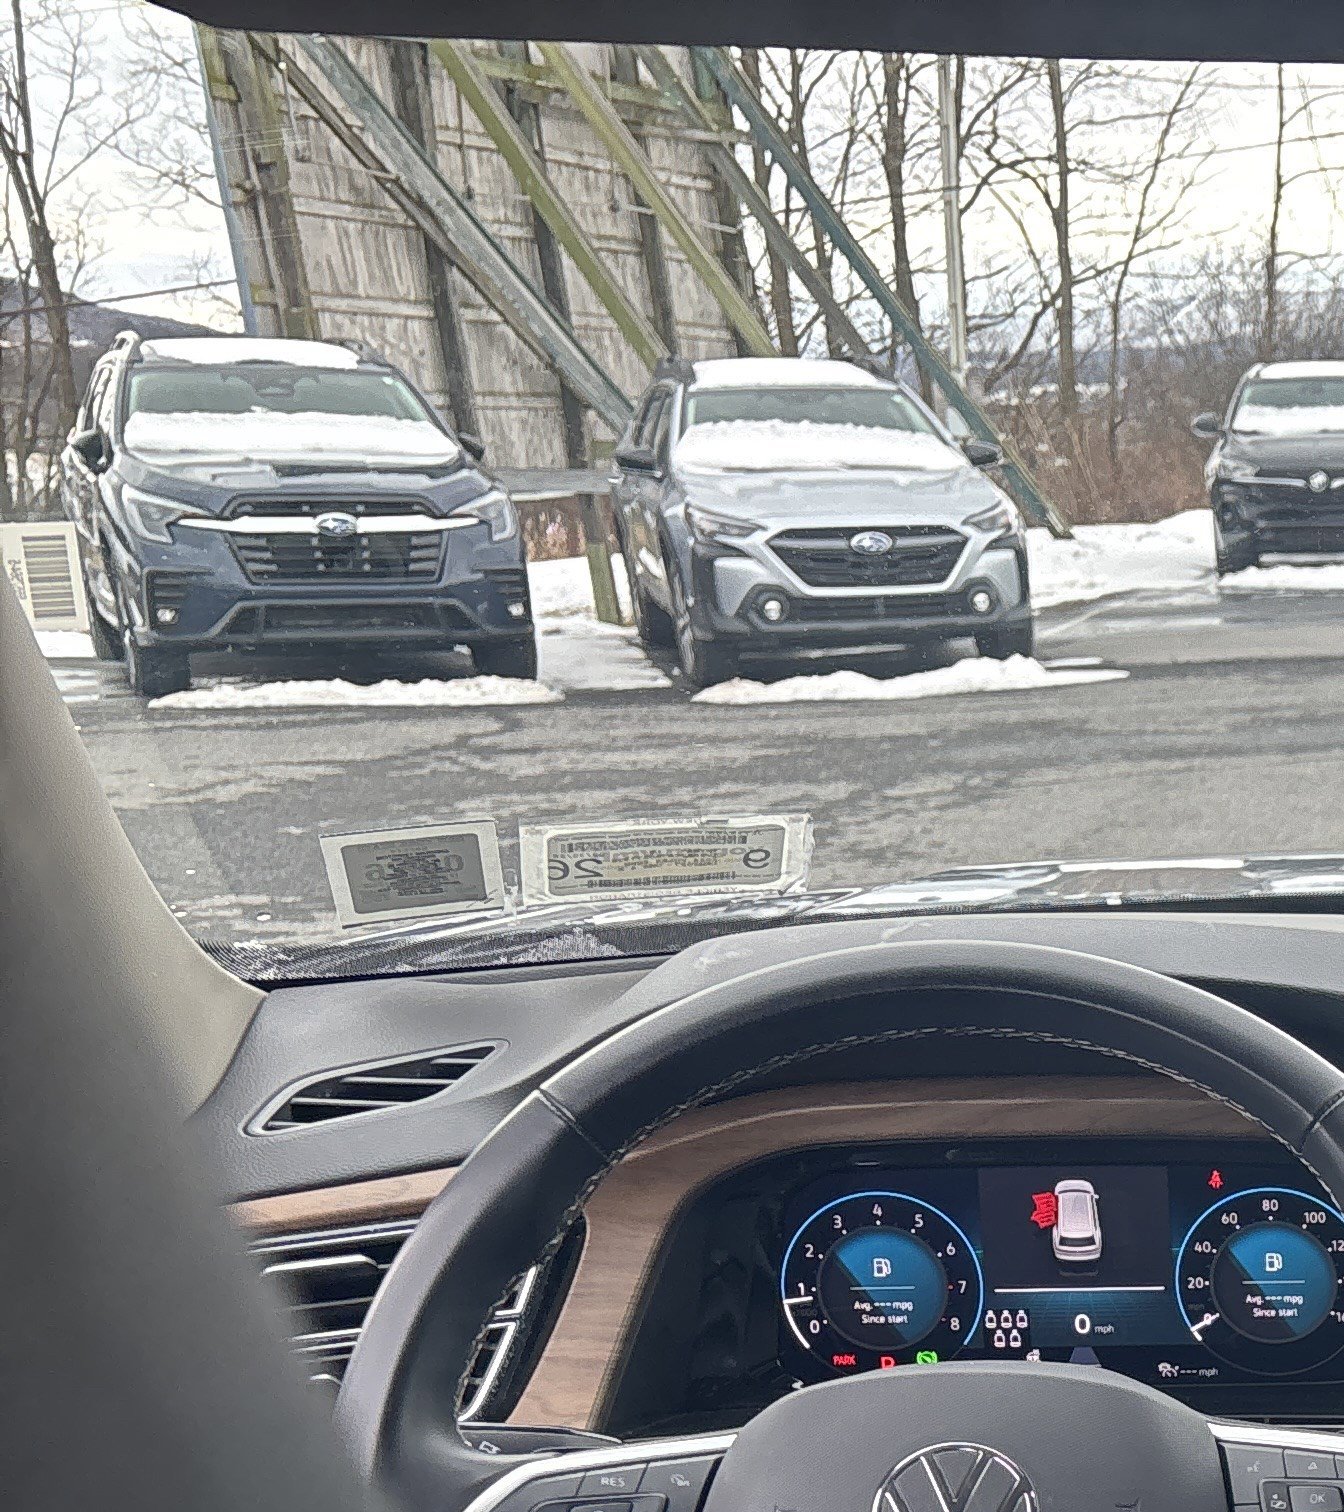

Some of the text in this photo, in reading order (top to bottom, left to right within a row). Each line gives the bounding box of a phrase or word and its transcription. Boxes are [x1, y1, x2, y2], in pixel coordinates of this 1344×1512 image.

[873, 1204, 883, 1217] 4
[1261, 1199, 1279, 1212] 80
[833, 1214, 843, 1229] 3
[914, 1213, 924, 1228] 5
[1221, 1212, 1238, 1225] 60
[1303, 1211, 1327, 1224] 100
[804, 1243, 815, 1258] 2
[946, 1242, 957, 1257] 6
[1194, 1241, 1211, 1254] 40
[797, 1282, 805, 1296] 1
[957, 1280, 967, 1294] 7
[1187, 1276, 1204, 1290] 20
[1252, 1307, 1299, 1318] Since start
[861, 1314, 909, 1325] Since start
[950, 1317, 960, 1331] 8
[1074, 1313, 1115, 1335] 0 mph
[810, 1320, 820, 1334] 0
[1199, 1366, 1219, 1377] mph
[600, 1476, 626, 1488] RES
[1309, 1493, 1326, 1504] OK
